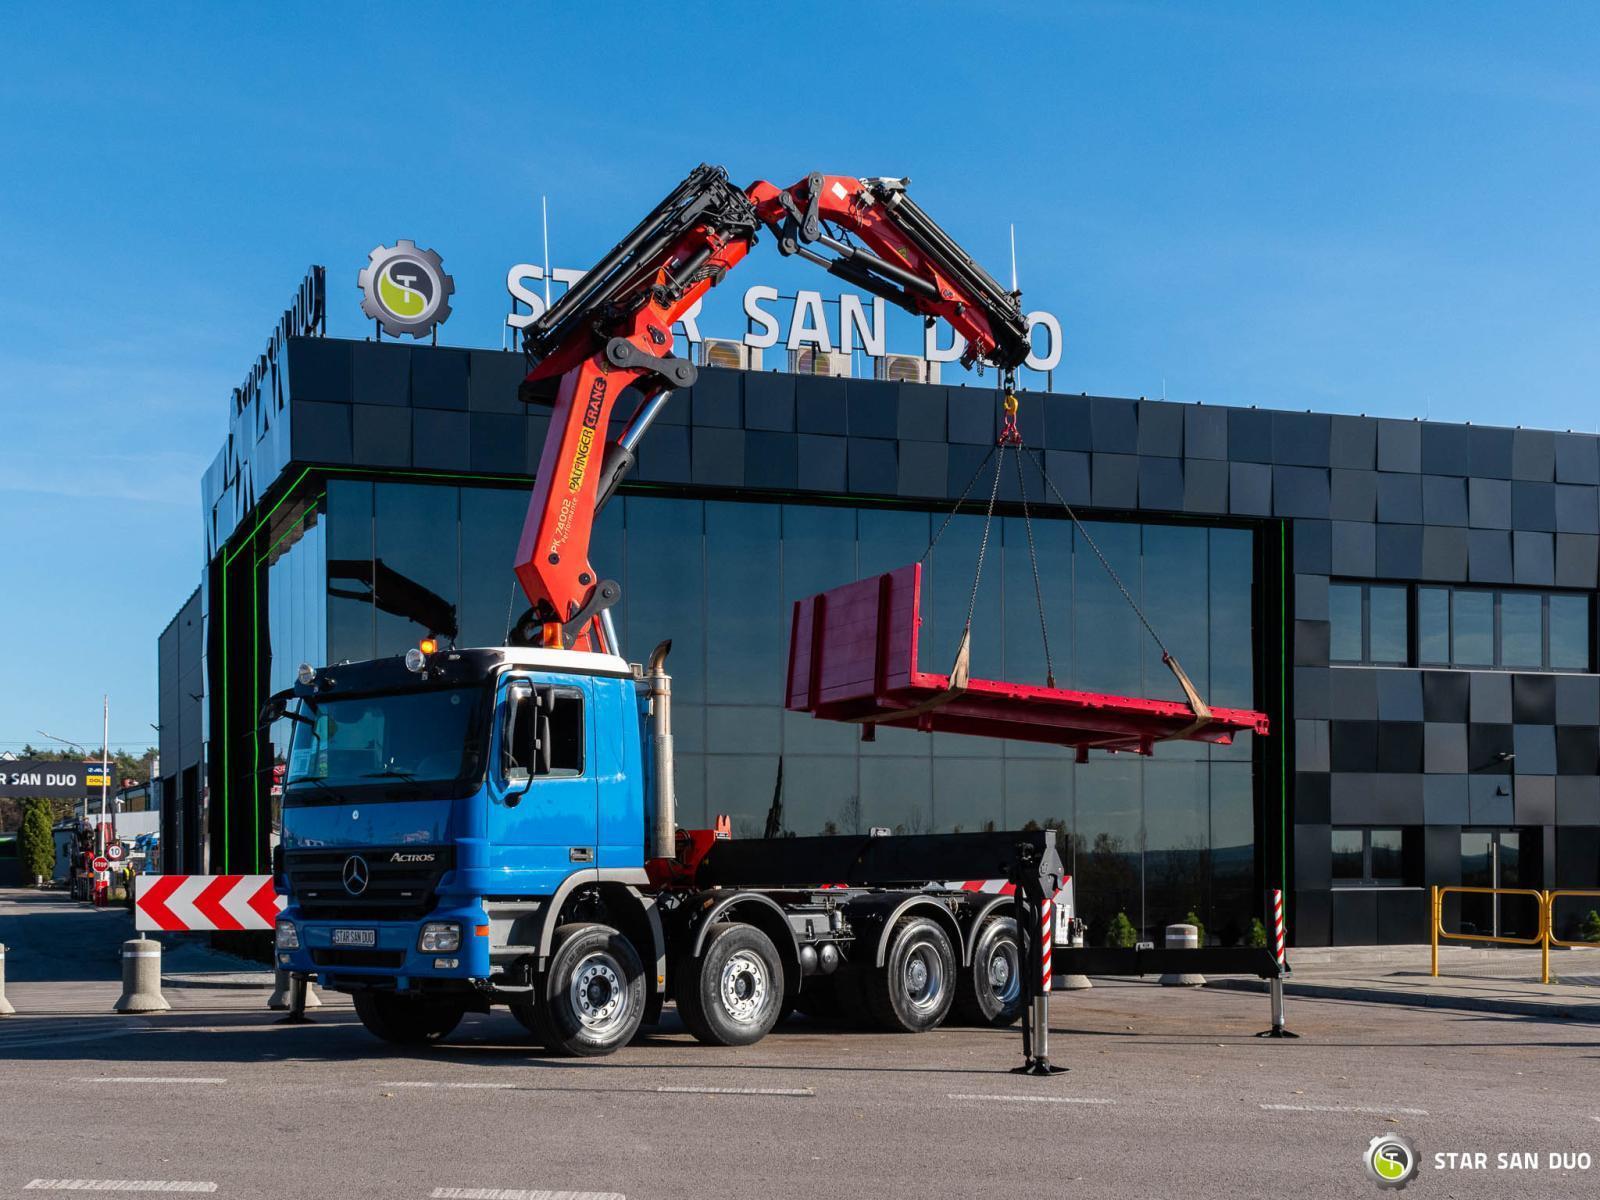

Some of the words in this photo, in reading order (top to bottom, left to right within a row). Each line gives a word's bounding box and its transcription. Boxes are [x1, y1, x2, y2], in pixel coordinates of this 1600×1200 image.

[507, 263, 702, 343] SR
[743, 285, 885, 358] SAN
[924, 307, 1063, 372] DO
[569, 428, 593, 491] PALFINGER
[585, 378, 606, 429] CRANE
[550, 538, 561, 554] PK
[556, 498, 571, 536] 74002
[11, 772, 41, 786] SAN
[46, 773, 77, 787] DUO
[110, 848, 120, 856] 10
[336, 930, 350, 944] STAR
[351, 930, 361, 944] SAN
[361, 931, 375, 946] DUO
